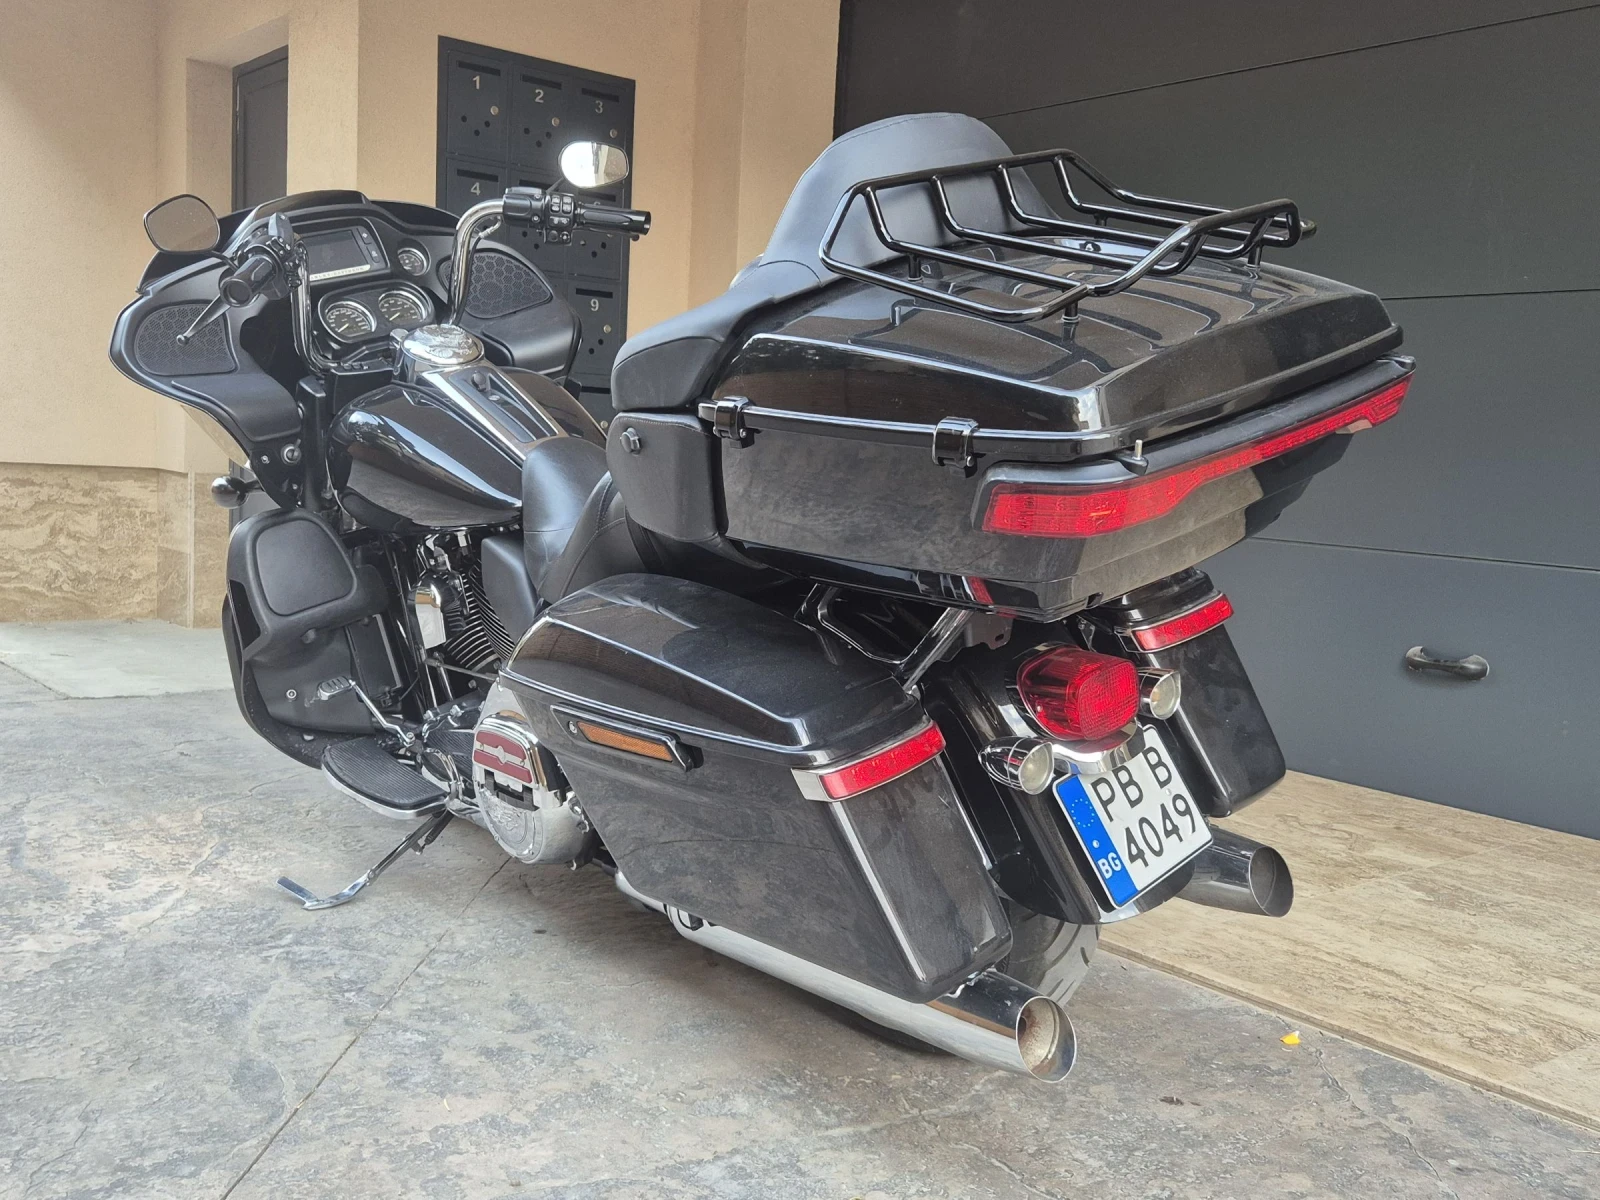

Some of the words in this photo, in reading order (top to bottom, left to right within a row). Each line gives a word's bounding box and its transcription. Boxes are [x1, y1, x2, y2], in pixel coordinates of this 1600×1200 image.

[472, 75, 481, 90] 1
[534, 89, 544, 103] 2
[595, 100, 604, 114] 3
[470, 182, 480, 196] 4
[590, 298, 599, 312] 9
[1124, 794, 1196, 867] 4049
[1098, 852, 1122, 879] BG
